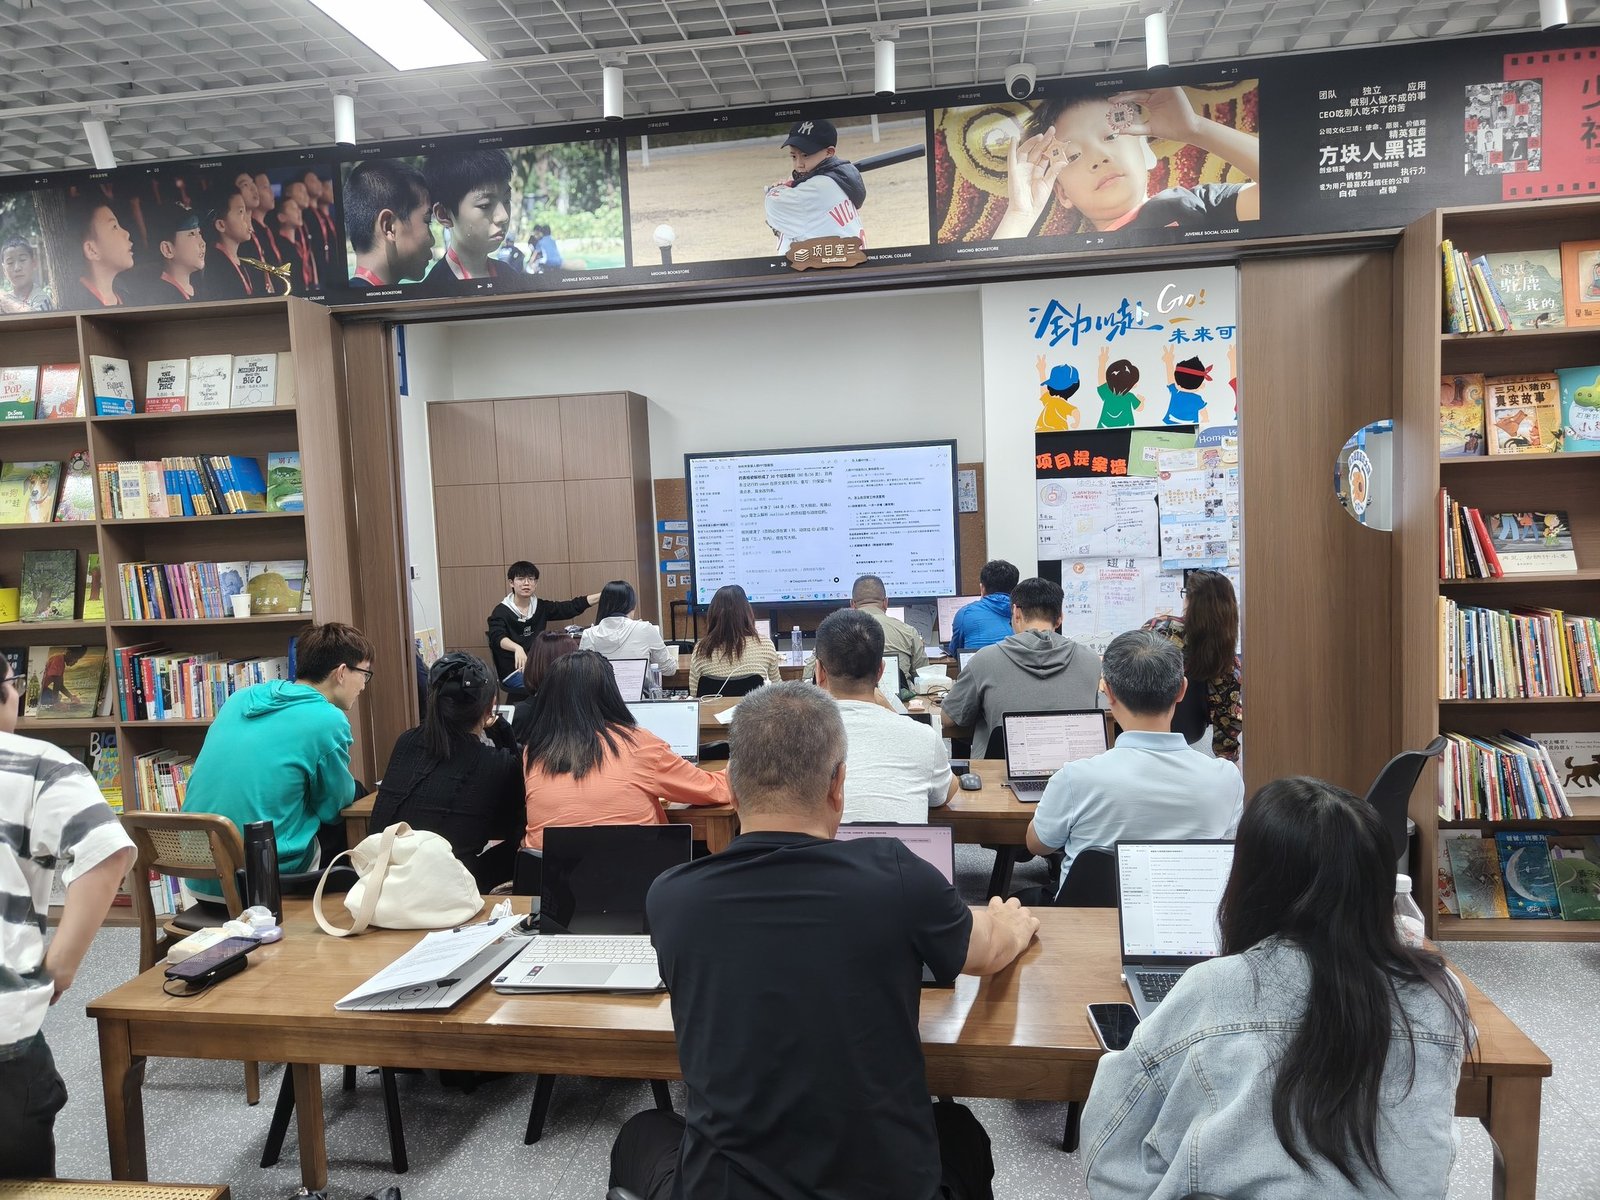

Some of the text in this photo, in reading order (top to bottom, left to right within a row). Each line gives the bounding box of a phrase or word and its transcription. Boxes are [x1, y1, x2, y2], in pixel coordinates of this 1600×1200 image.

[1319, 81, 1426, 100] 团队 独立 应用
[1350, 91, 1426, 107] 做别人做不成的事
[1319, 104, 1406, 118] CEO吃别人吃不了的苦
[1319, 138, 1426, 166] 方块人黑话
[1319, 166, 1346, 174] 创业精英
[1346, 166, 1426, 180] 销售力 执行力
[1338, 189, 1357, 198] 自信
[812, 243, 856, 257] 项目室三
[1500, 275, 1540, 293] 驼鹿
[1526, 298, 1554, 310] 我的
[242, 376, 262, 384] BIG O
[1495, 382, 1551, 394] 三只小猪的
[1496, 392, 1546, 407] 真实故事
[1200, 435, 1224, 444] Hom
[1036, 450, 1127, 475] 项目提案墙
